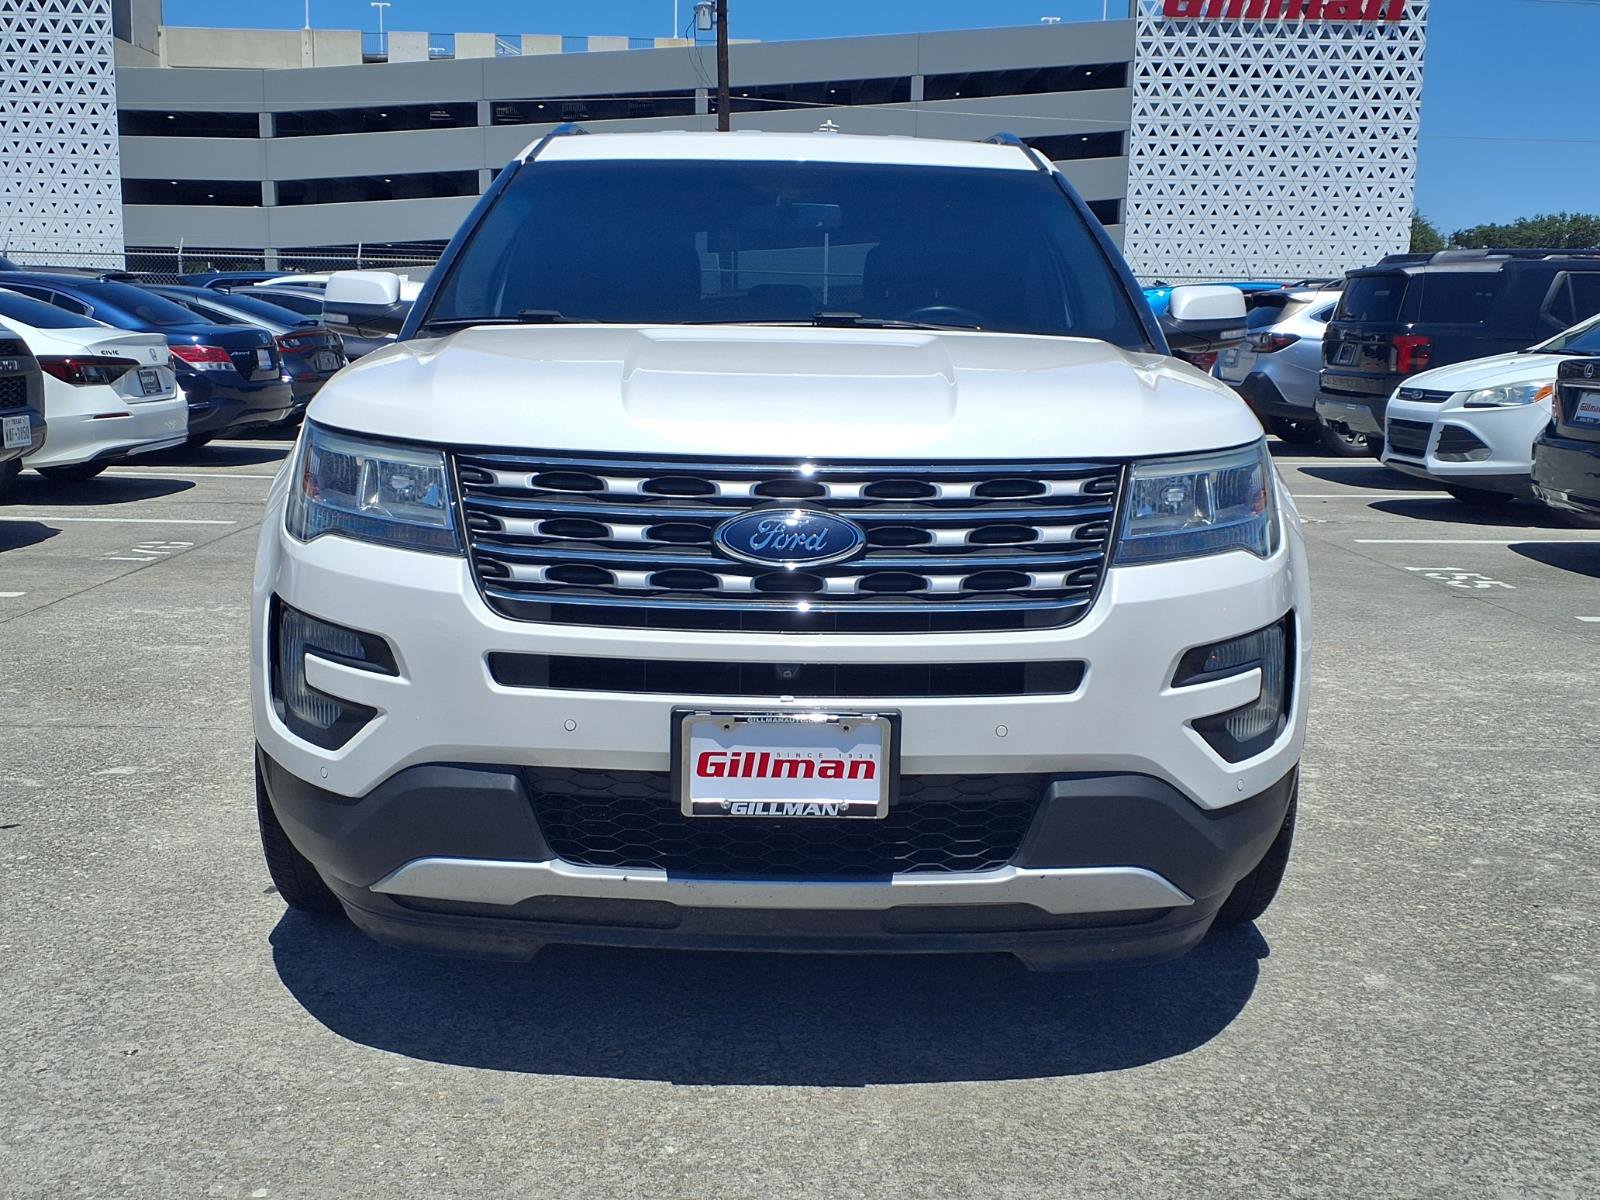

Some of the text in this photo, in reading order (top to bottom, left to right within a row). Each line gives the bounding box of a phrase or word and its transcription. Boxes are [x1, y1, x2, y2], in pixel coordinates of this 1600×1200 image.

[750, 519, 829, 551] Ford
[696, 751, 876, 780] Gillman
[730, 802, 840, 816] GILLMAN
